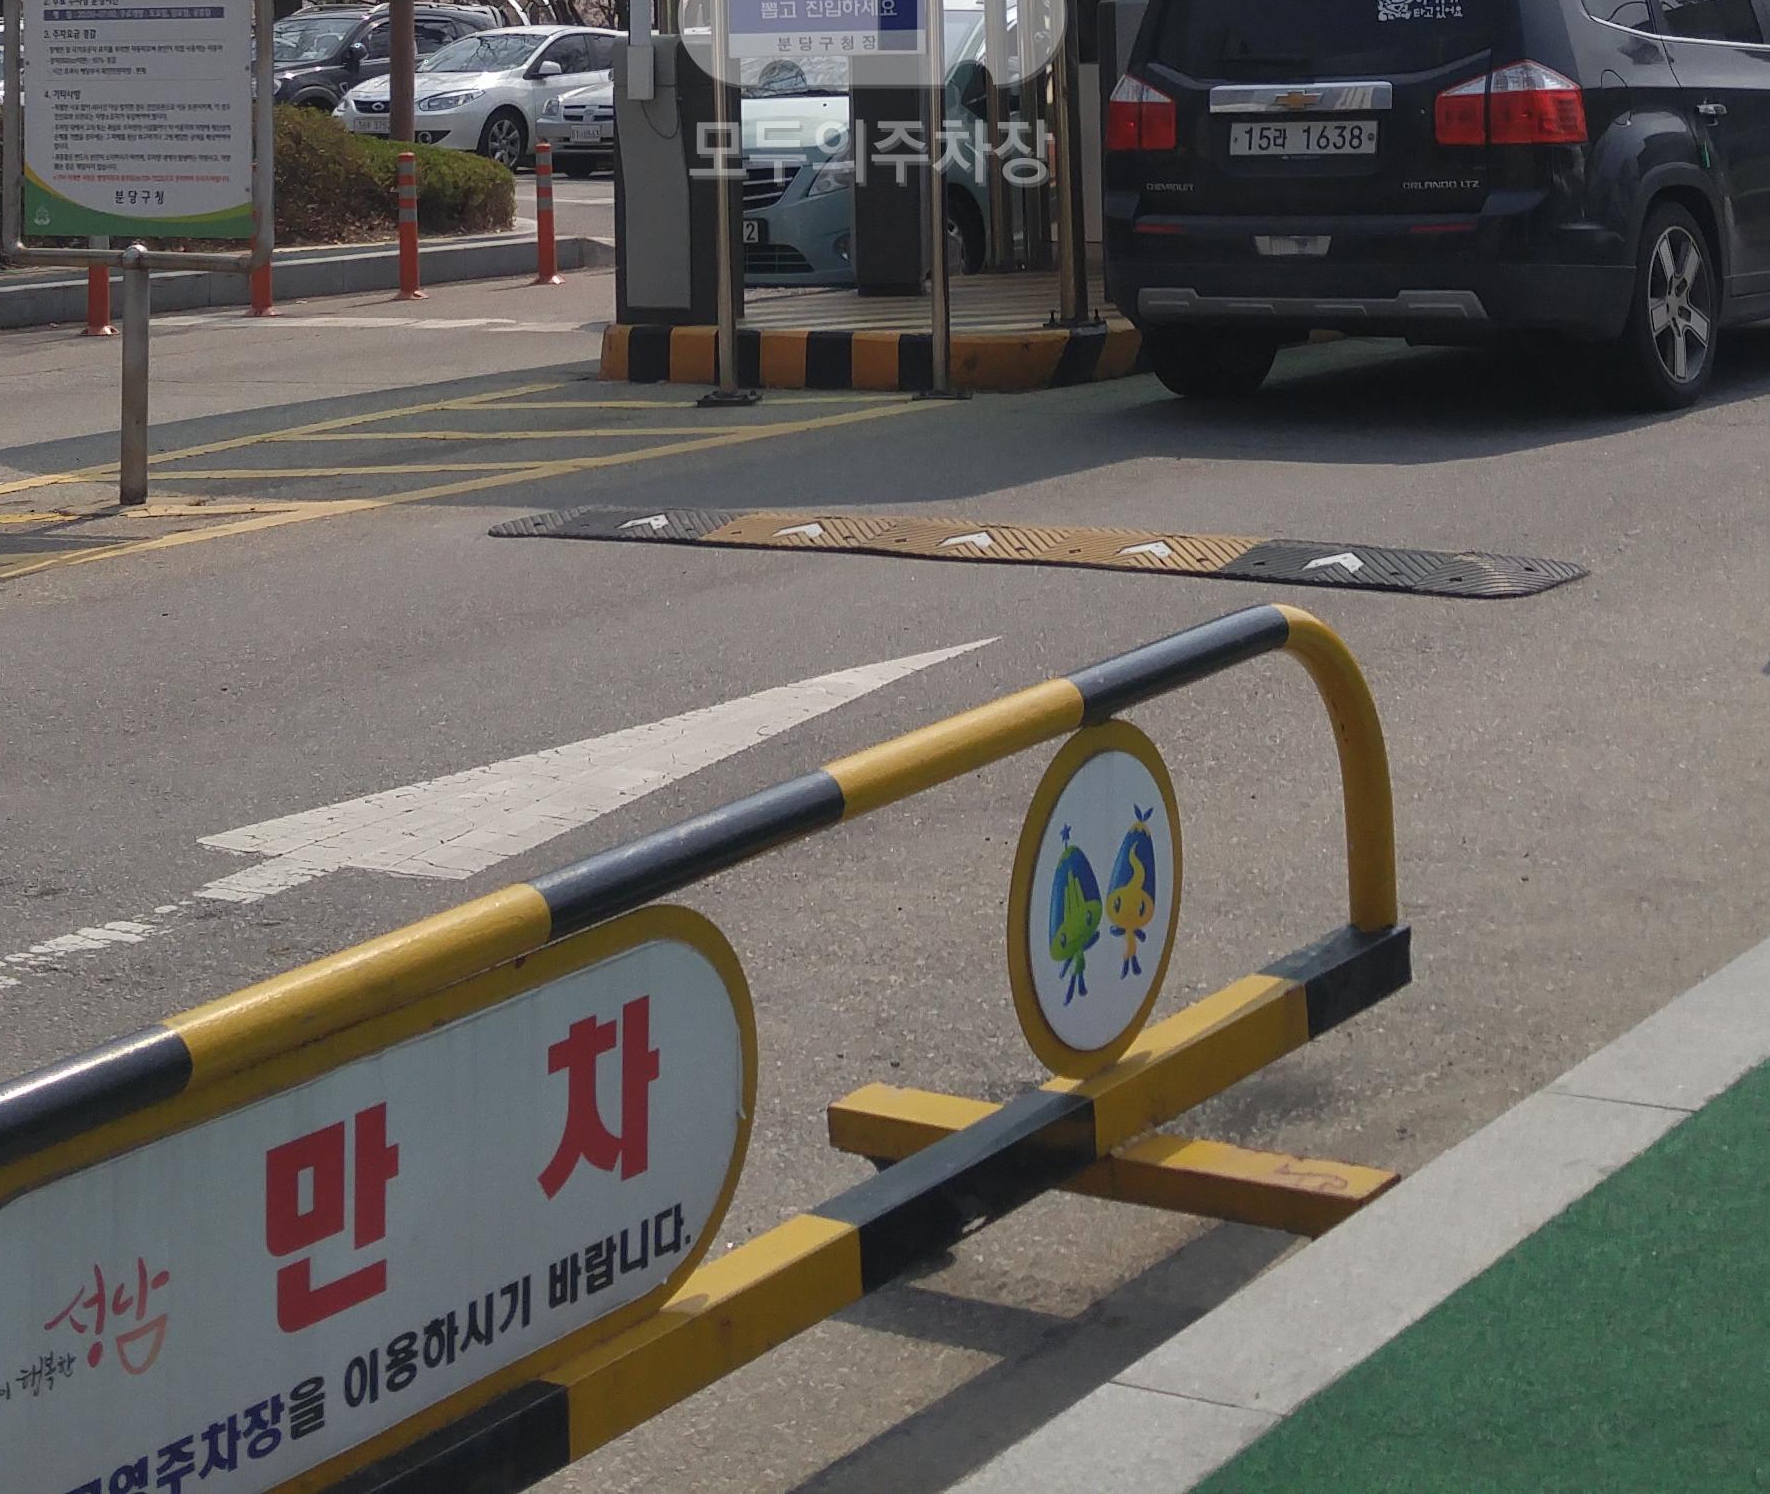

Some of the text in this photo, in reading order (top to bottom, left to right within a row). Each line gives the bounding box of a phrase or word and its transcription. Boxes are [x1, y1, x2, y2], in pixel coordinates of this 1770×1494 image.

[761, 1, 797, 19] 뽑고
[1413, 4, 1463, 19] 타고 있어요
[778, 35, 877, 51] 분당구청장
[1244, 125, 1364, 151] 15라 1638
[115, 190, 165, 205] 분당구청
[63, 1201, 693, 1494] 영주차장을 이용하시기 바랍니다.
